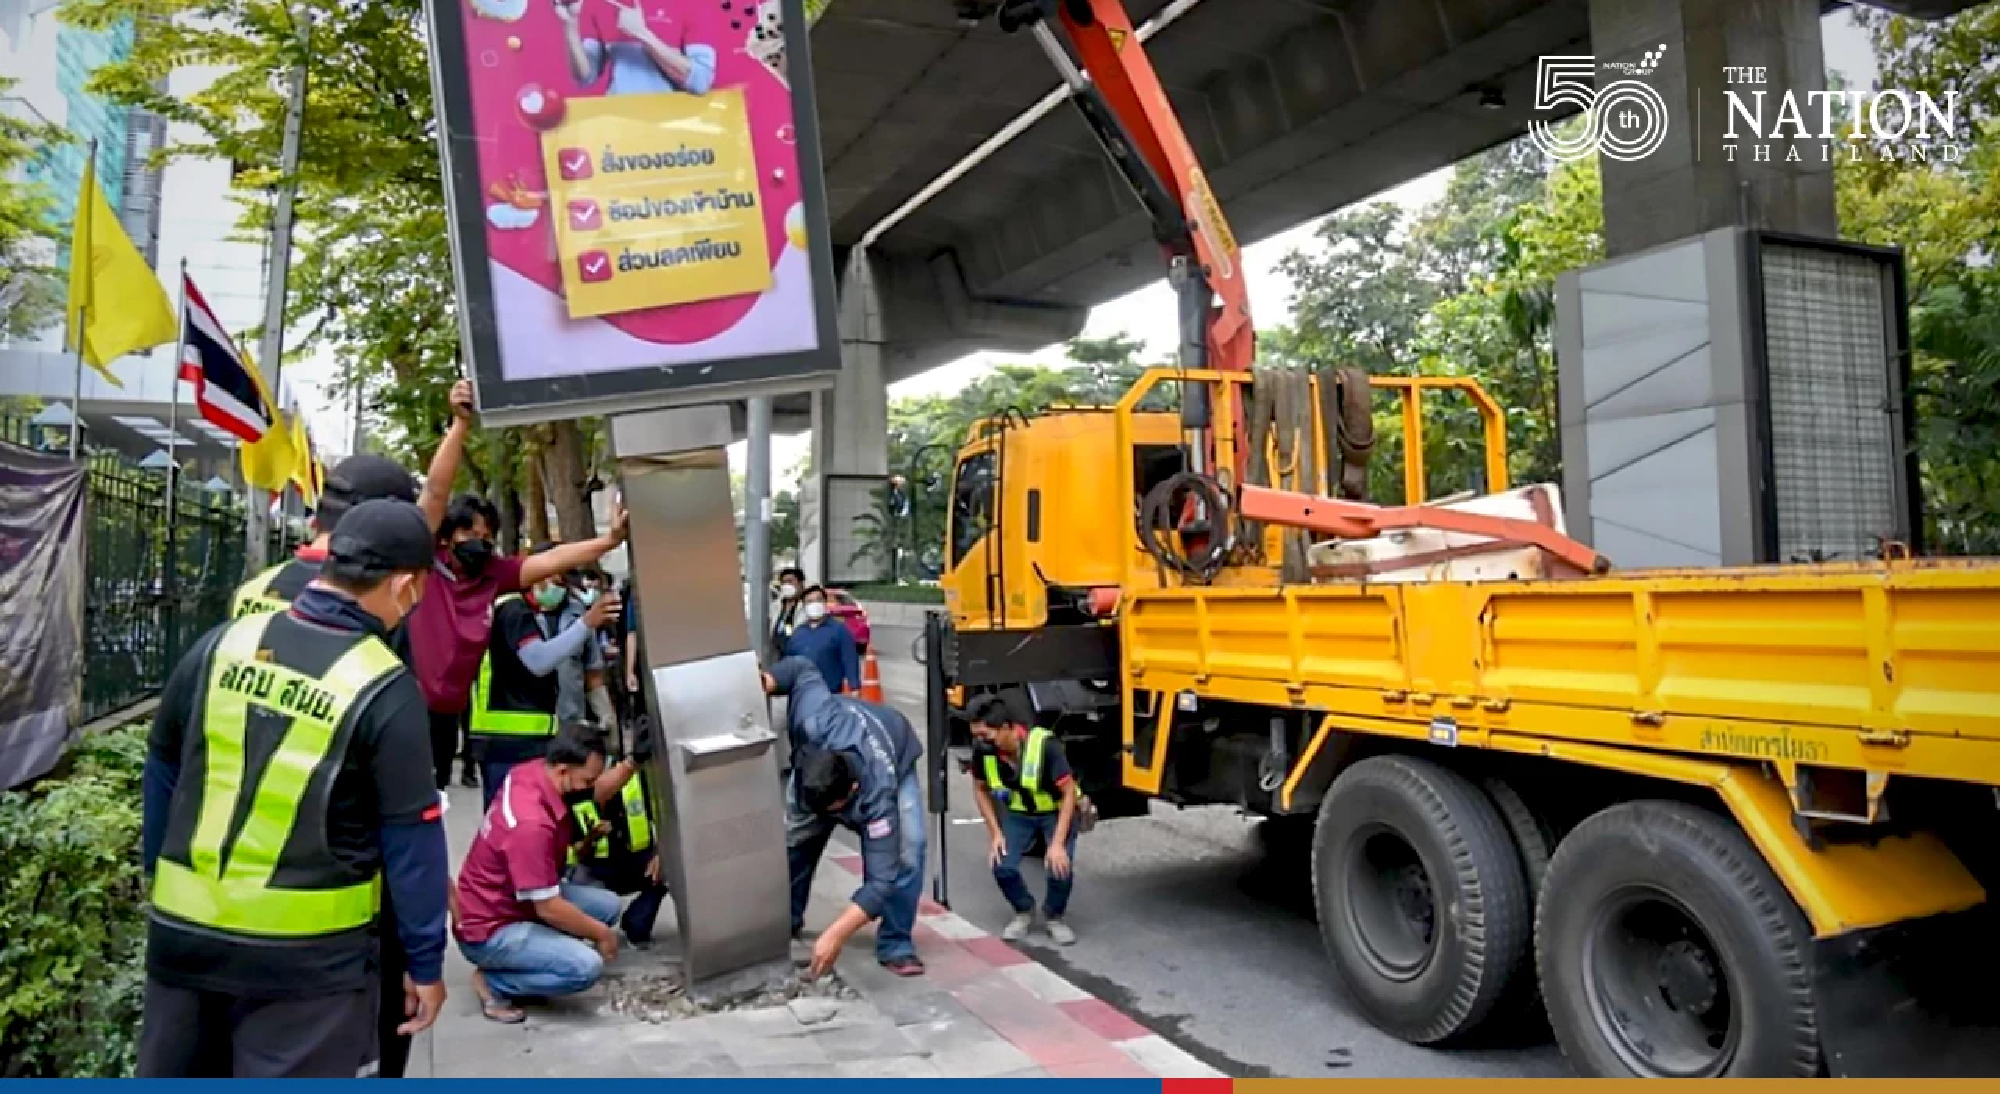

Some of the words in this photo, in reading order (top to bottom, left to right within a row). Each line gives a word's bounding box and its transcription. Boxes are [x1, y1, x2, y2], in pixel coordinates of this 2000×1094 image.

[600, 144, 715, 173] สั่งของอร่อย
[609, 188, 756, 222] ช้อปของเข้าบ้าน
[618, 238, 741, 272] ส่วนลดเพียบ
[1700, 724, 1829, 761] สำนักการโยธา
